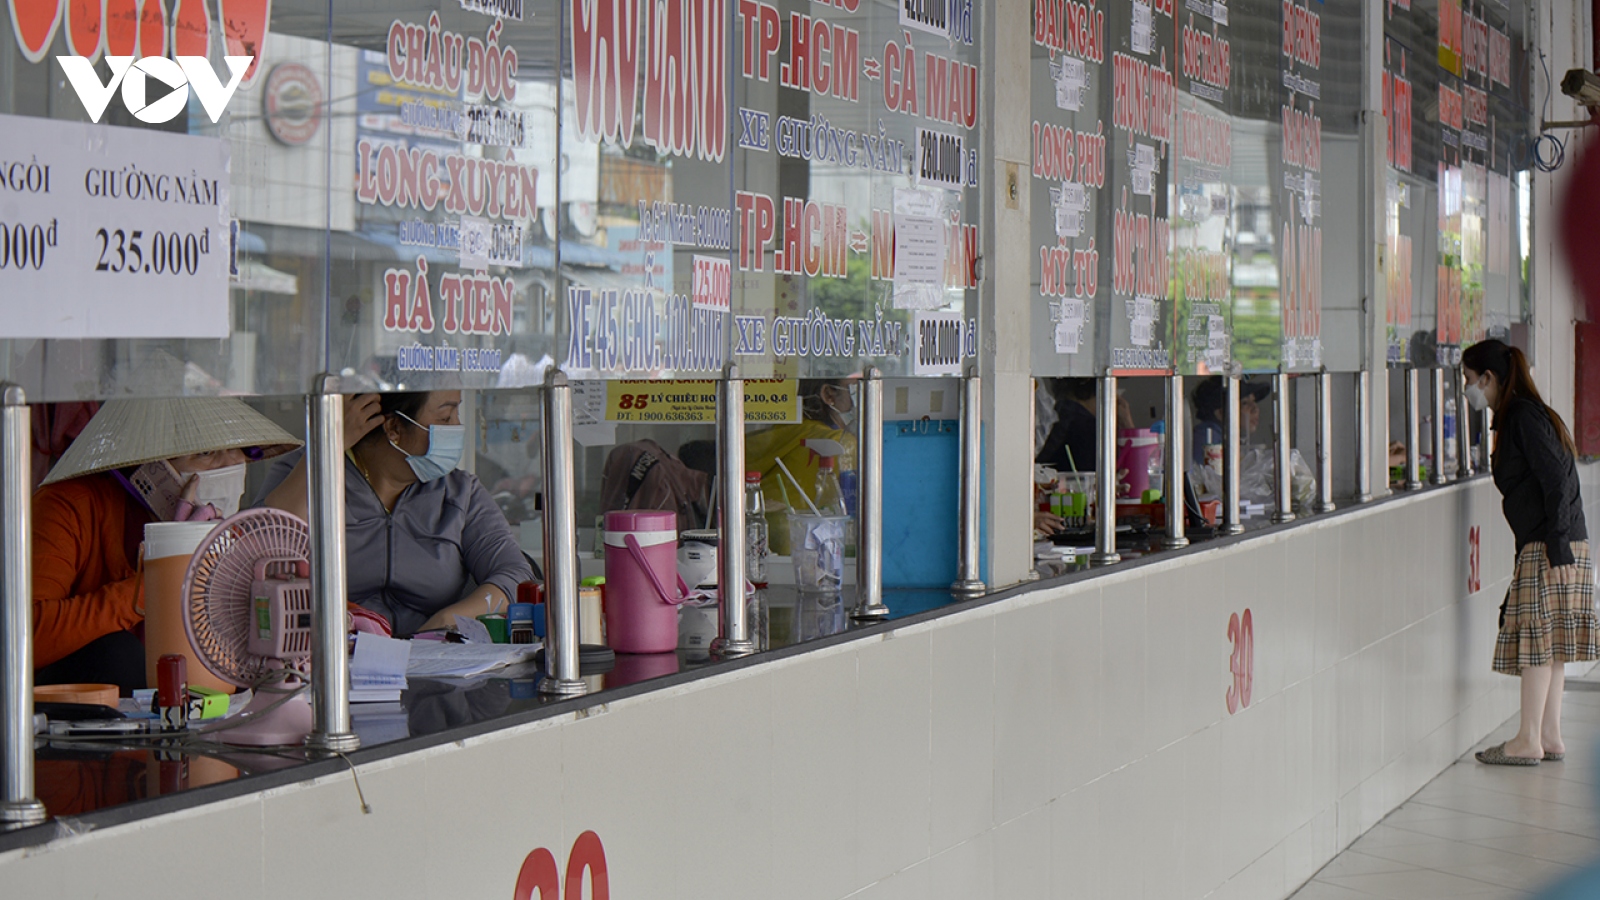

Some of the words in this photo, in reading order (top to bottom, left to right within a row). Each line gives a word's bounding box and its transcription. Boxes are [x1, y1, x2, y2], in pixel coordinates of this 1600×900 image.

[387, 10, 464, 91] CHÂU
[467, 17, 519, 101] ĐỐC
[738, 1, 860, 103] TP.HCM
[883, 30, 919, 116] CÀ
[925, 52, 977, 130] MAU
[739, 107, 769, 151] XE
[775, 113, 857, 167] GIƯỜNG
[1033, 120, 1074, 182] LONG
[1076, 119, 1106, 189] PHÚ
[85, 164, 169, 202] GIƯỜNG
[358, 141, 441, 211] LONG
[445, 148, 539, 223] XUYÊN
[95, 227, 210, 275] 235.000đ
[735, 190, 847, 279] TP.HCM
[943, 209, 978, 290] ĂN
[384, 254, 435, 333] HÀ
[440, 269, 514, 336] TIÊN
[568, 286, 592, 371] XE
[595, 288, 618, 372] 45
[735, 315, 766, 355] XE
[772, 307, 855, 357] GIƯỜNG
[618, 393, 649, 410] 85
[651, 393, 664, 403] LÝ
[665, 393, 698, 404] CHIÊU
[770, 394, 788, 404] Q.6
[638, 411, 704, 421] 1900.636363
[1468, 525, 1480, 595] 31
[1225, 607, 1253, 715] 30
